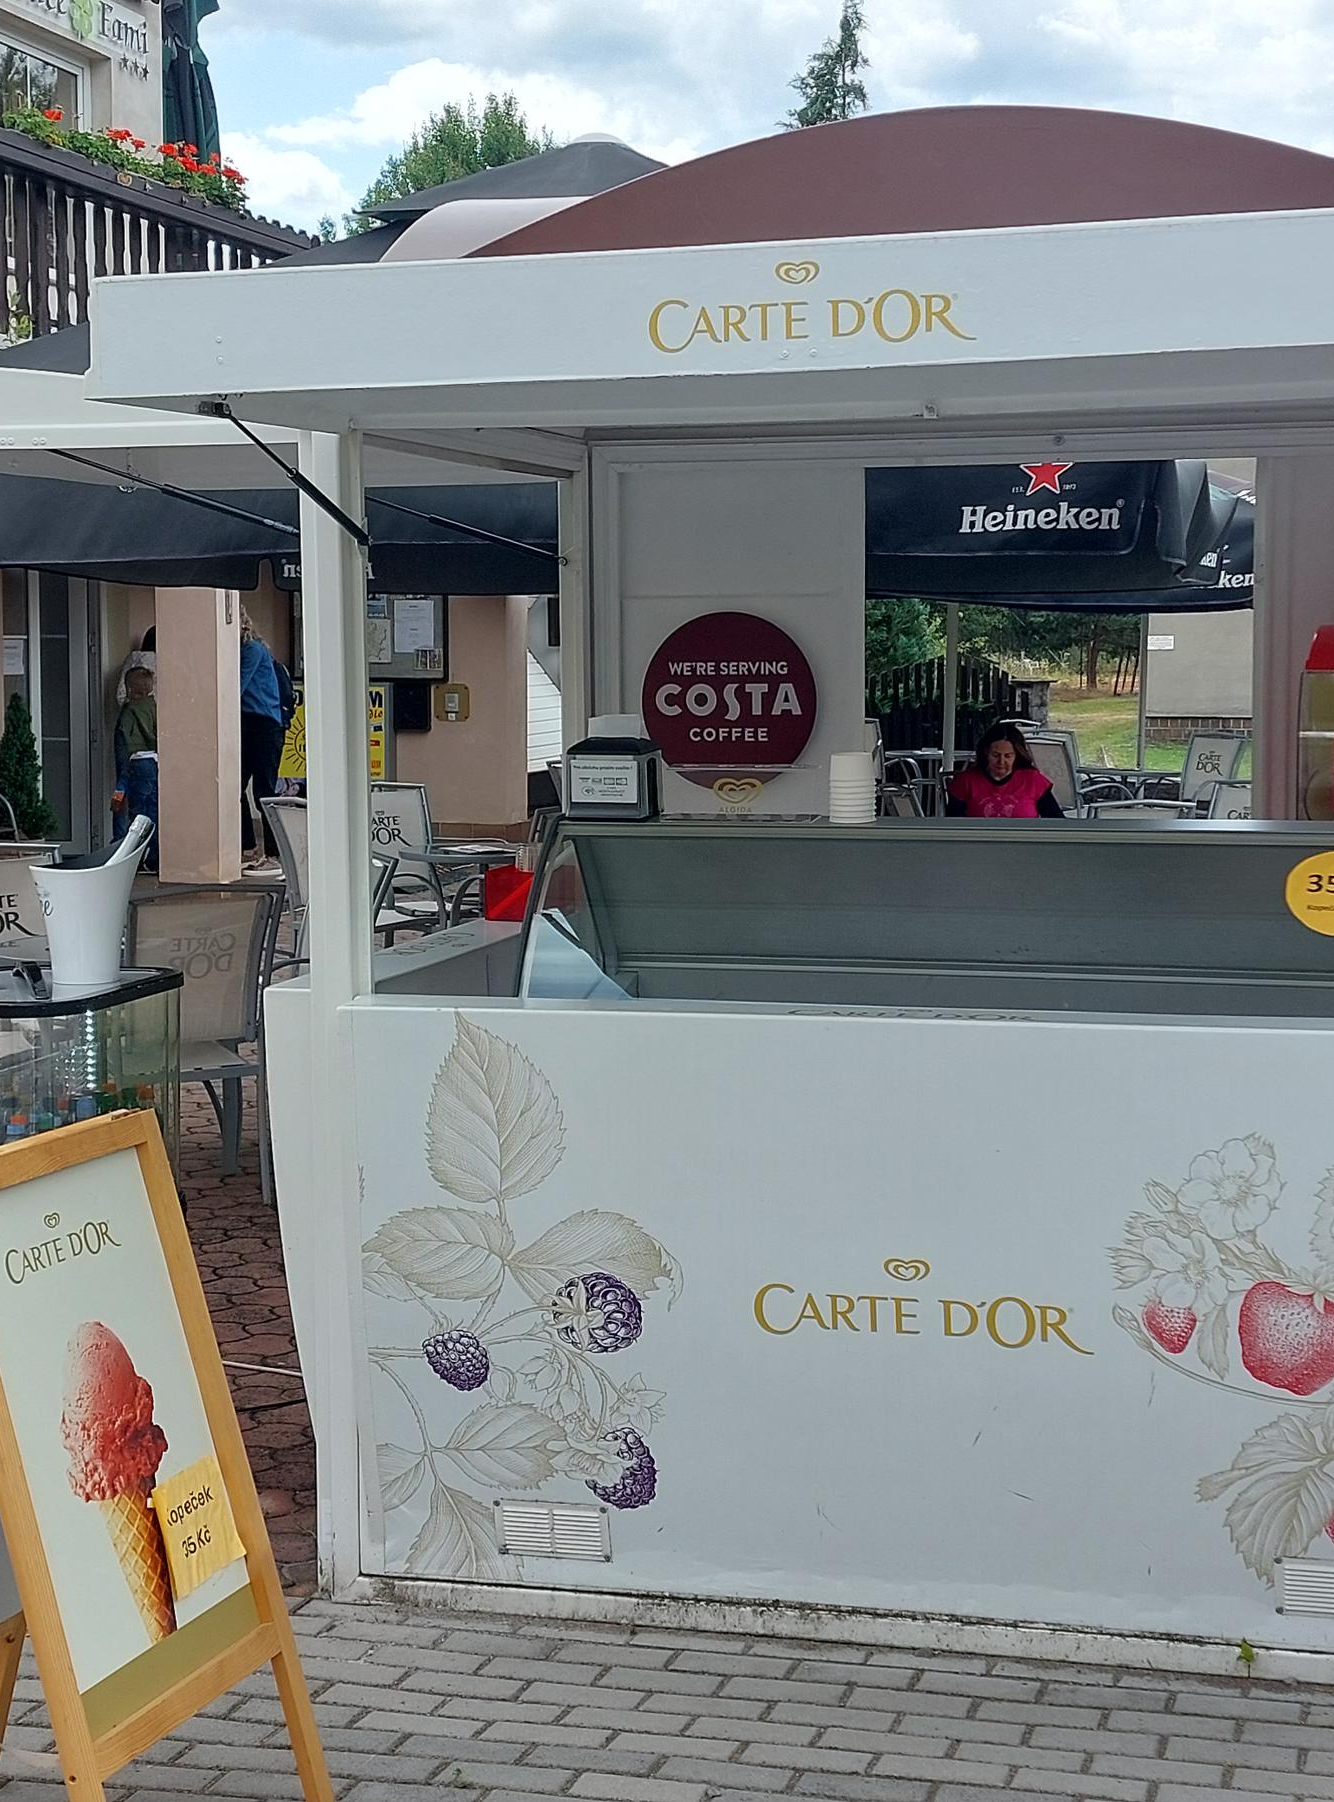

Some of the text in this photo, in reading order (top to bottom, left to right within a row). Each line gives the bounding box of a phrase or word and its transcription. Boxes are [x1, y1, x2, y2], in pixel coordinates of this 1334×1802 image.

[99, 0, 149, 54] Fami
[648, 288, 978, 353] CARTE D'OR
[959, 498, 1124, 534] Heineken
[668, 661, 789, 676] WE'RE SERVING
[655, 683, 803, 721] COSTA
[689, 727, 769, 742] COFFEE
[371, 816, 400, 828] ARTE
[5, 1221, 122, 1285] CARTE D'OR
[753, 1283, 1096, 1356] CARTE D'OR
[196, 1524, 212, 1549] Kč
